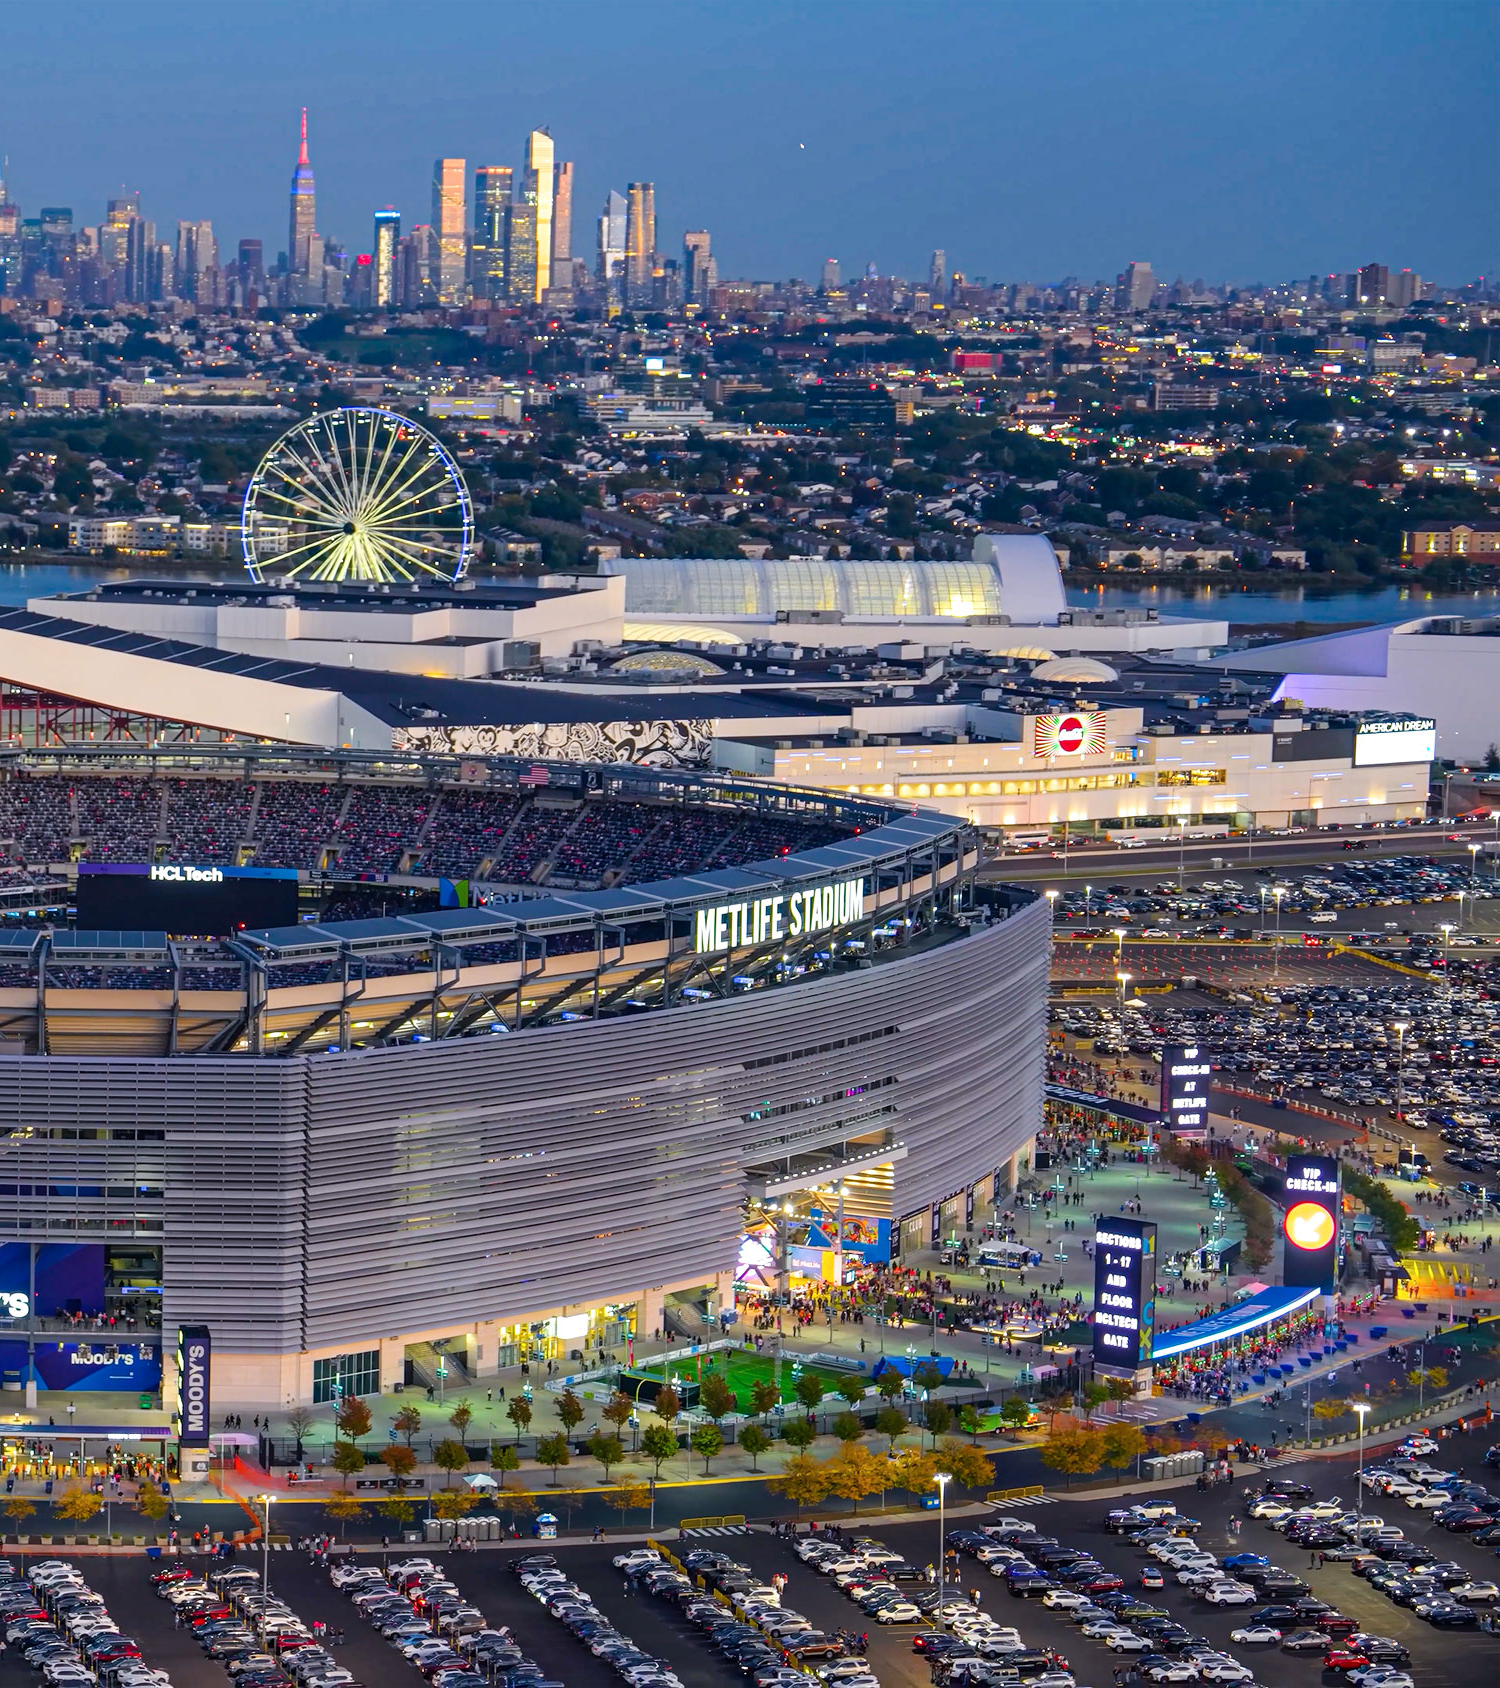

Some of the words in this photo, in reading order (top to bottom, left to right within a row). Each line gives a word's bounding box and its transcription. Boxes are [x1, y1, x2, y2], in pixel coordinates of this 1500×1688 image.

[1359, 721, 1402, 734] AMERICAN
[1404, 720, 1434, 731] DREAM
[150, 865, 223, 882] HCLTech
[473, 885, 550, 907] MetL
[696, 896, 783, 954] METLIFE
[789, 878, 865, 936] STADIUM
[1184, 1048, 1199, 1059] VIP
[1184, 1081, 1197, 1092] AT
[1177, 1113, 1200, 1125] GATE
[1303, 1167, 1321, 1180] VIP
[1286, 1178, 1337, 1193] CHECK-IN
[909, 1218, 923, 1233] CLUB
[1096, 1231, 1141, 1250] SECTIONS
[1105, 1253, 1111, 1265] 1
[1120, 1255, 1132, 1268] 17
[1106, 1273, 1127, 1288] AND
[1101, 1292, 1133, 1309] FLOOR
[1103, 1333, 1129, 1349] GATE
[71, 1353, 134, 1366] MOODY'S
[187, 1345, 205, 1432] MOODY'S
